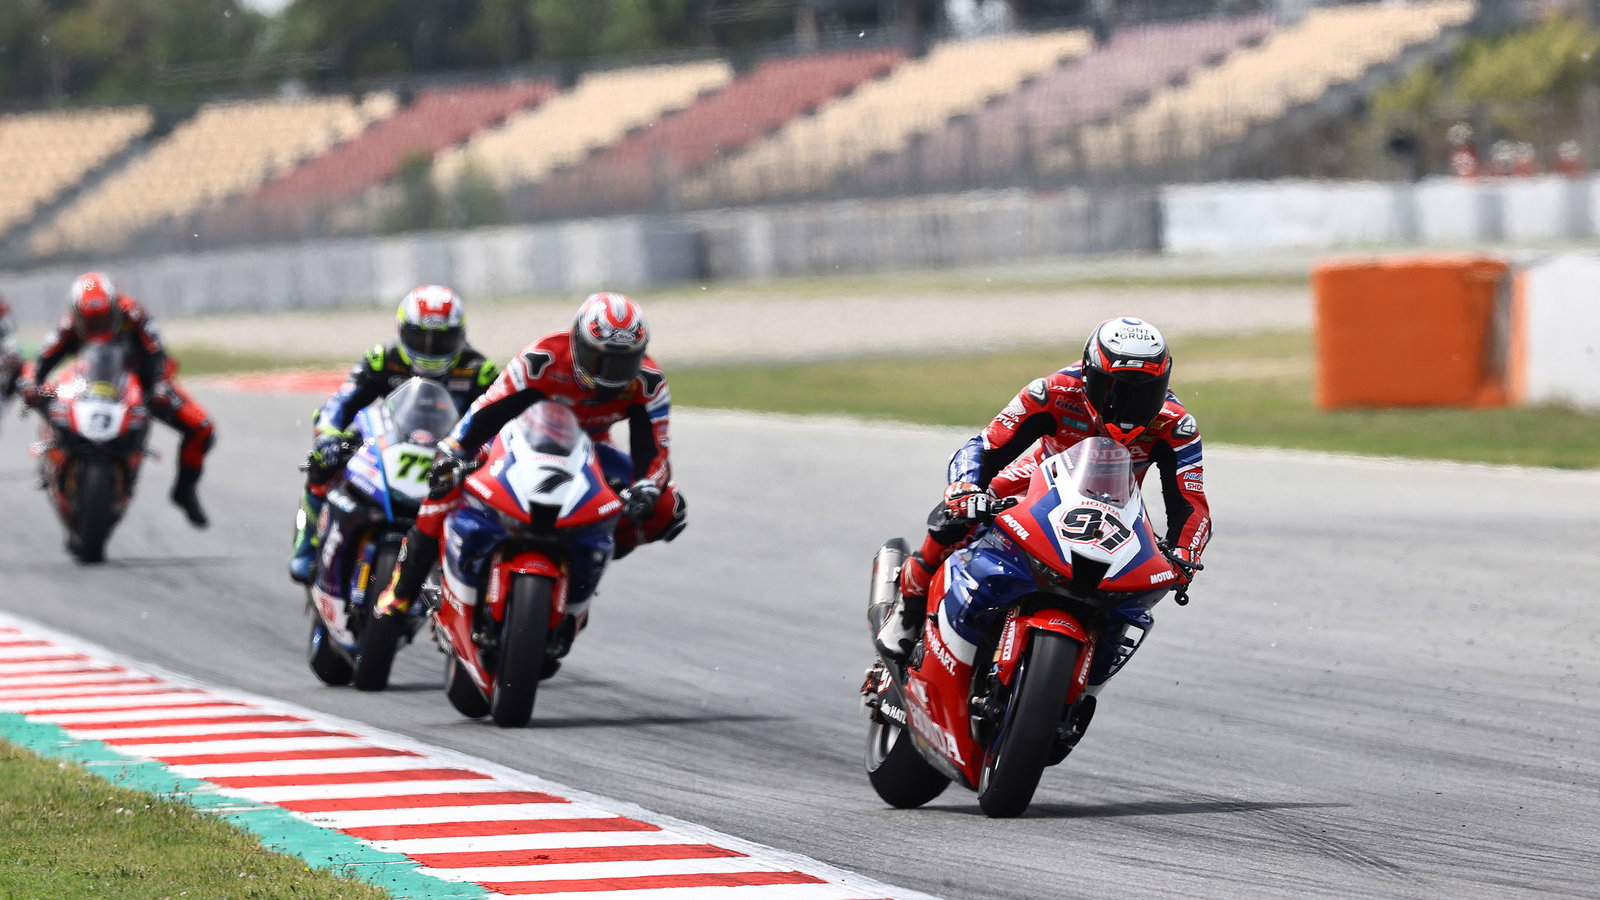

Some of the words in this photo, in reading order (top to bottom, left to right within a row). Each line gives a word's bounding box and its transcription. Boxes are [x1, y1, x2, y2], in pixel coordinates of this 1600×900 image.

[1111, 359, 1160, 370] LS2
[398, 452, 432, 482] 77
[529, 466, 574, 494] 7
[1081, 501, 1121, 519] HONDA
[1001, 514, 1030, 541] MOTUL
[1060, 507, 1133, 552] 97
[1151, 570, 1176, 585] MOTUL
[905, 699, 966, 766] HONDA
